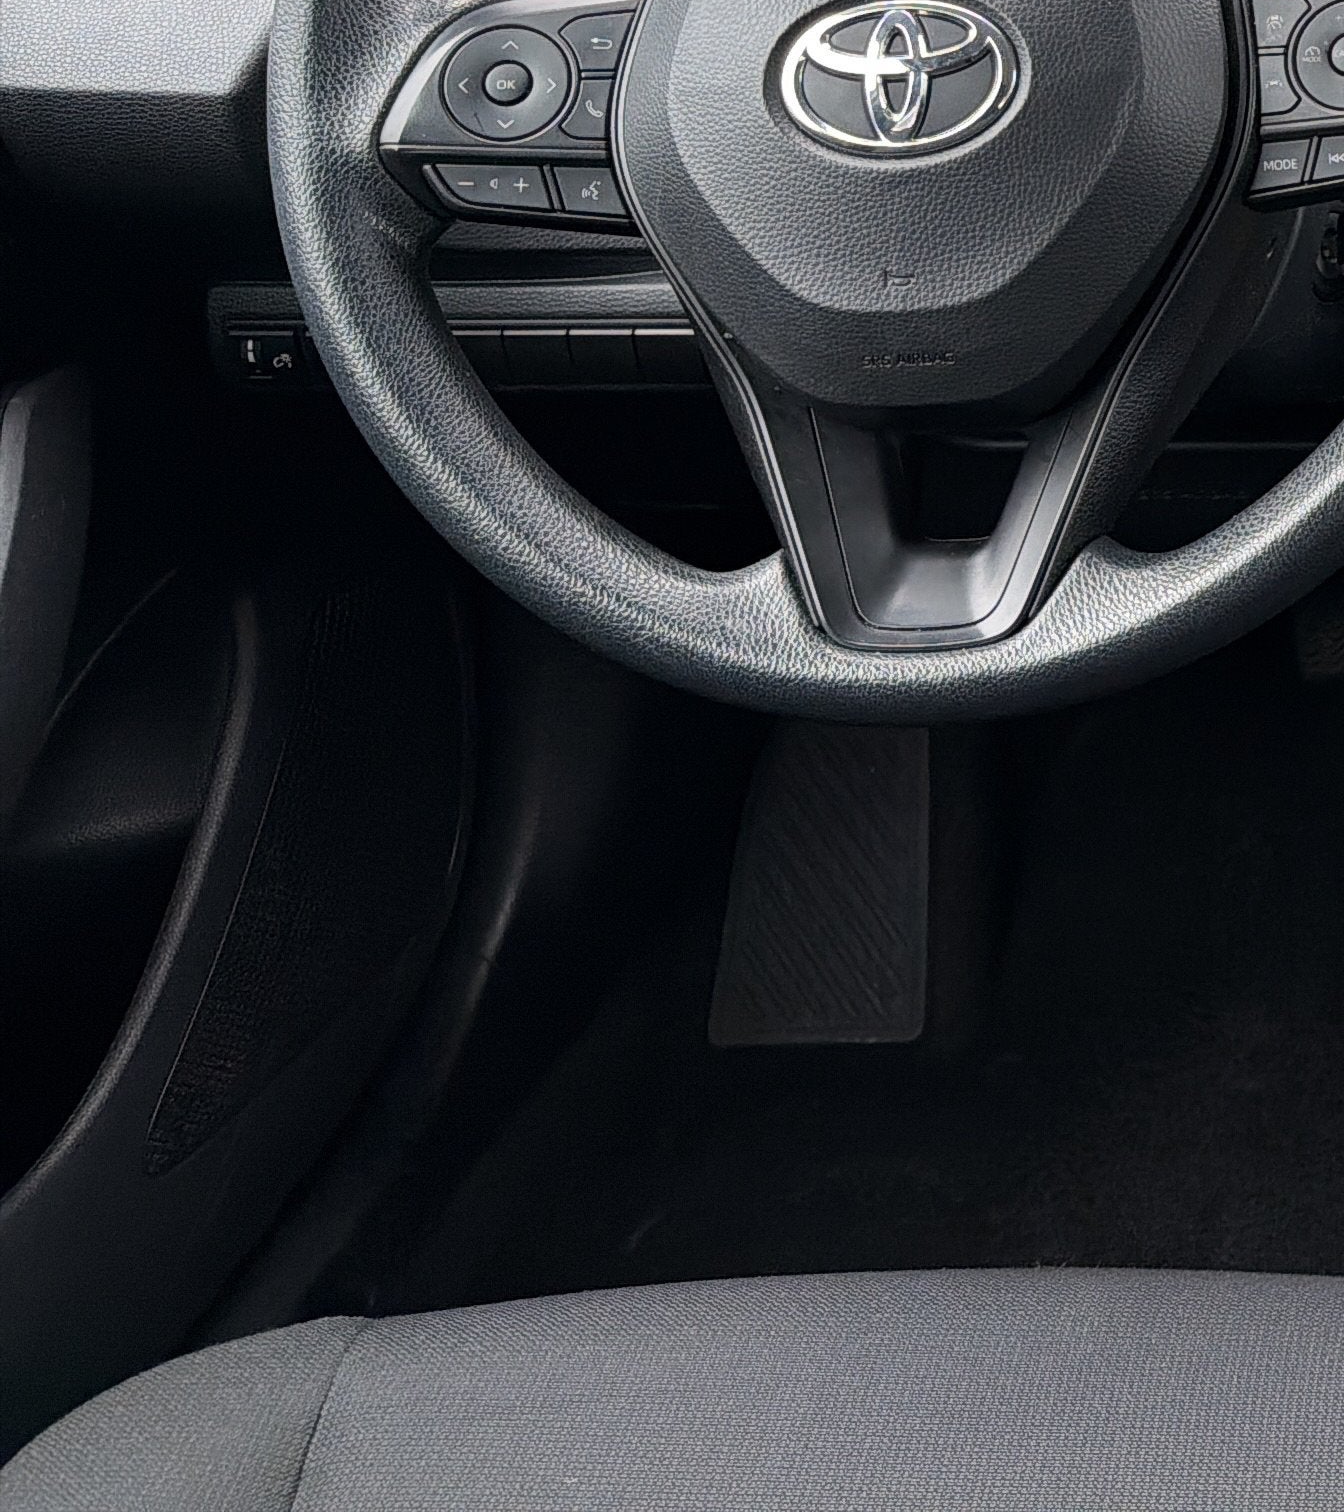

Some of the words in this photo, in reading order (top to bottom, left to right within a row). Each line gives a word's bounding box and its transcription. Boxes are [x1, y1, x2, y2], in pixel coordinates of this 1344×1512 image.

[496, 80, 516, 90] OK
[1263, 159, 1298, 172] MODE
[862, 354, 892, 369] SRS
[896, 352, 956, 368] AIRBAG
